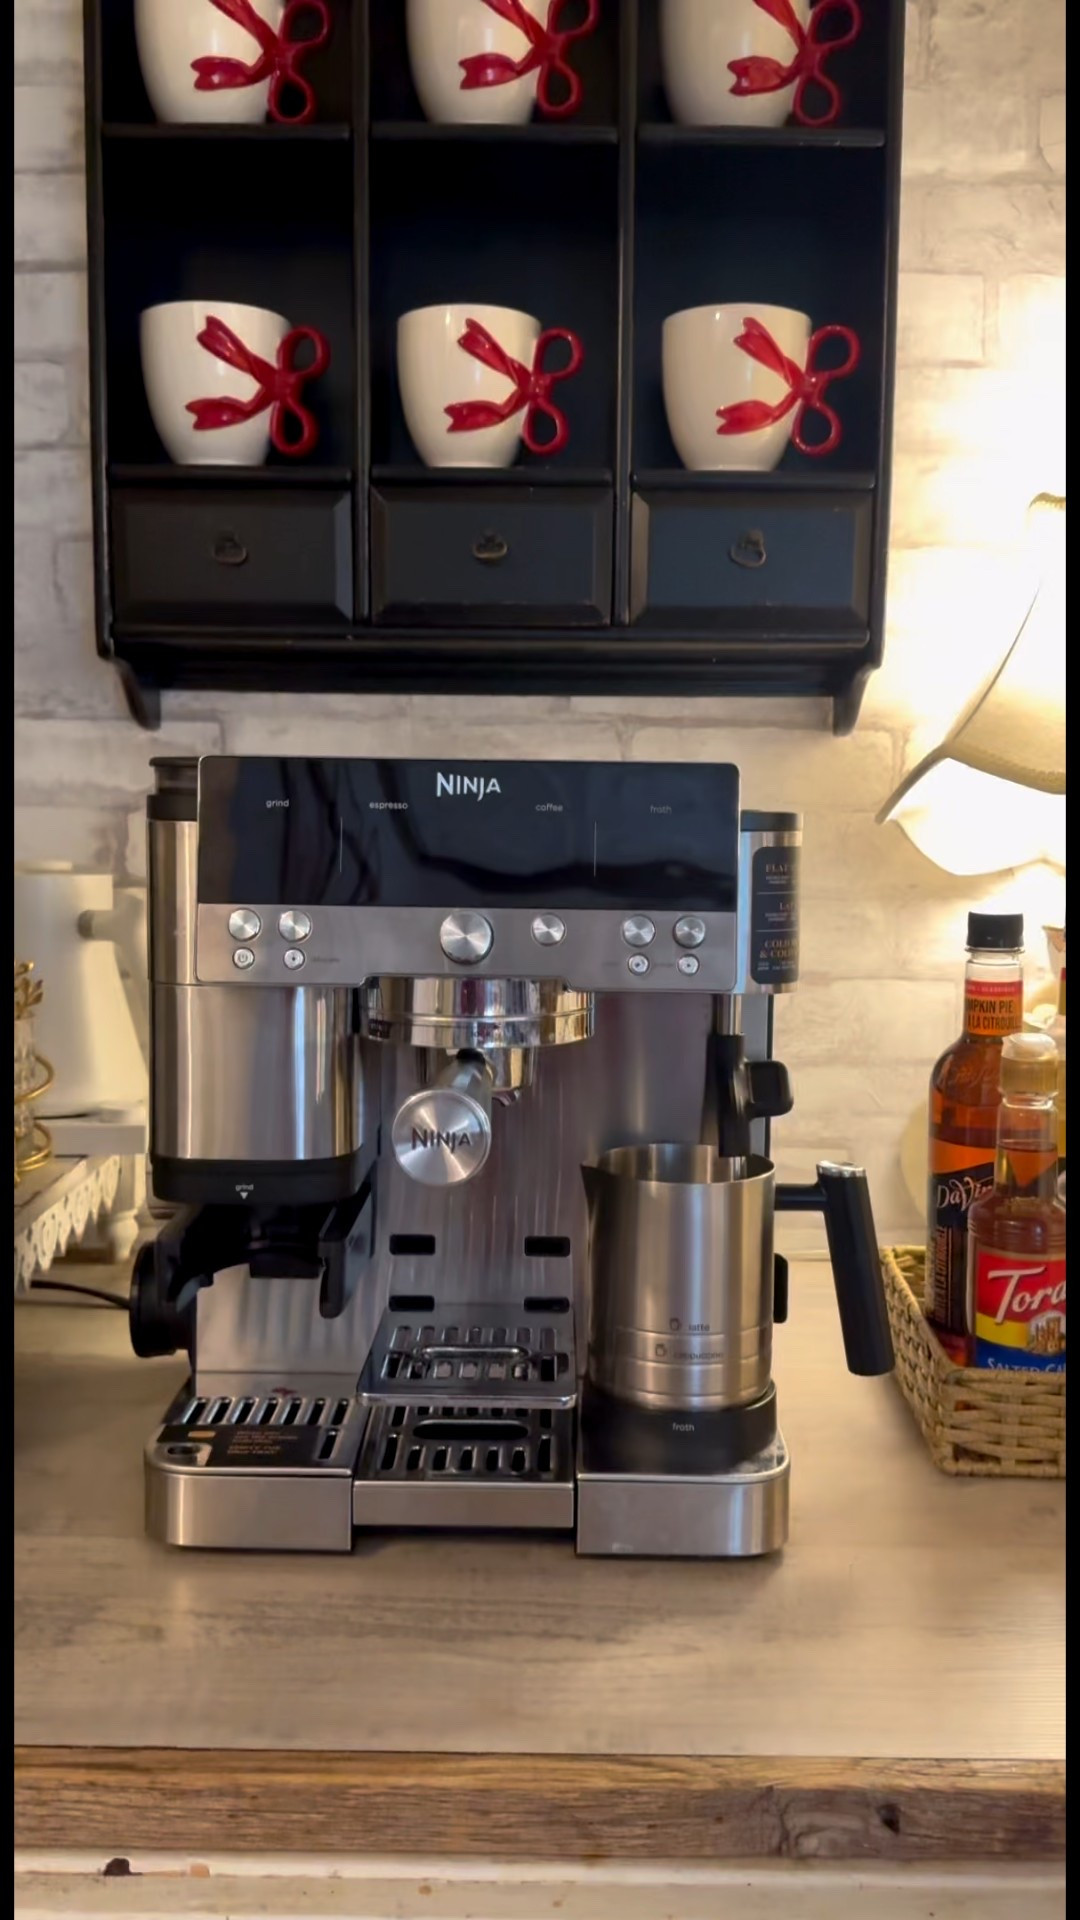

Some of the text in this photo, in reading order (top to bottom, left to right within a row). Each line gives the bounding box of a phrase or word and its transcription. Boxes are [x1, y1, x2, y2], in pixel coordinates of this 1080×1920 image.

[436, 771, 502, 802] NINJA
[265, 799, 290, 809] grind
[368, 801, 409, 810] espresso
[535, 803, 563, 812] coffee
[649, 804, 672, 814] froth
[999, 999, 1014, 1014] PIE
[411, 1127, 471, 1154] NINJA
[688, 1323, 710, 1331] latte
[672, 1422, 695, 1432] froth
